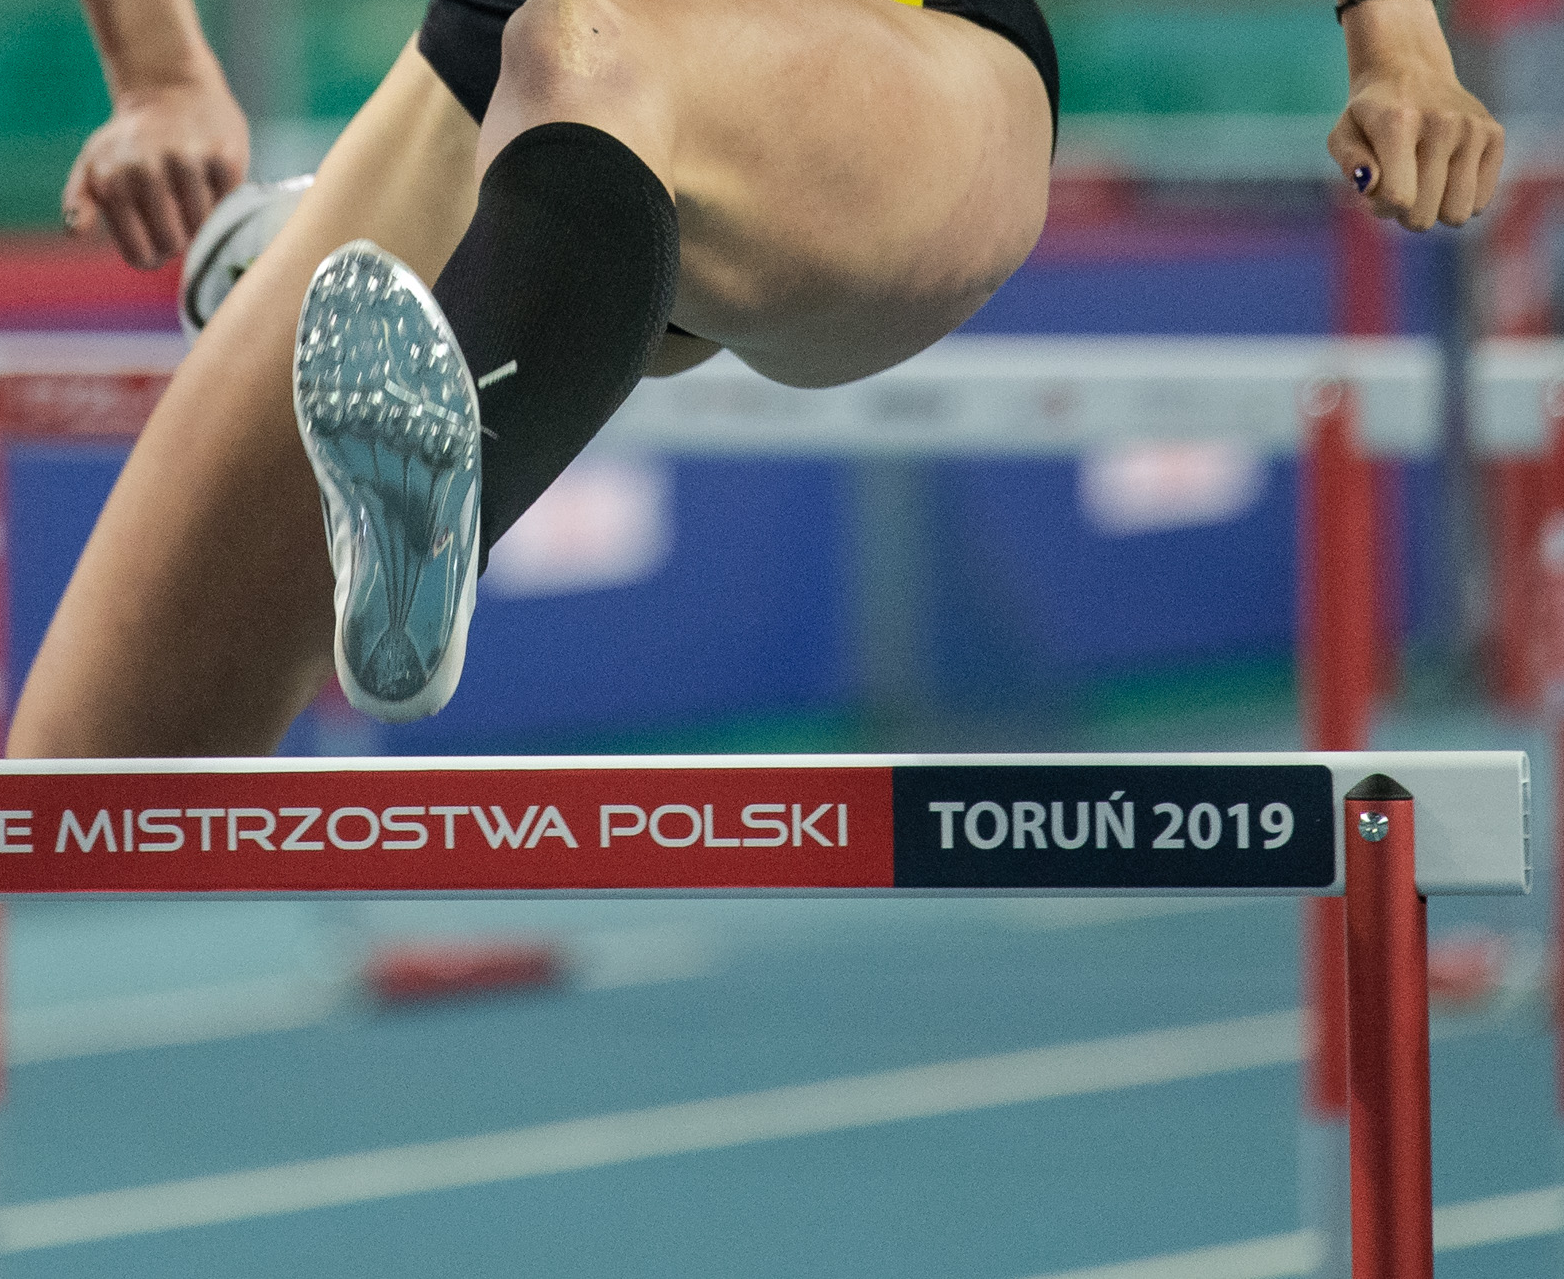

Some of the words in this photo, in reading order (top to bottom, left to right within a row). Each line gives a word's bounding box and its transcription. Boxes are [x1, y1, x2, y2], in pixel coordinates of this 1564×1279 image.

[54, 805, 580, 853] MISTRZOSTWA
[599, 802, 849, 849] POLSKI
[928, 790, 1136, 851] TORUŃ
[1152, 801, 1295, 851] 2019
